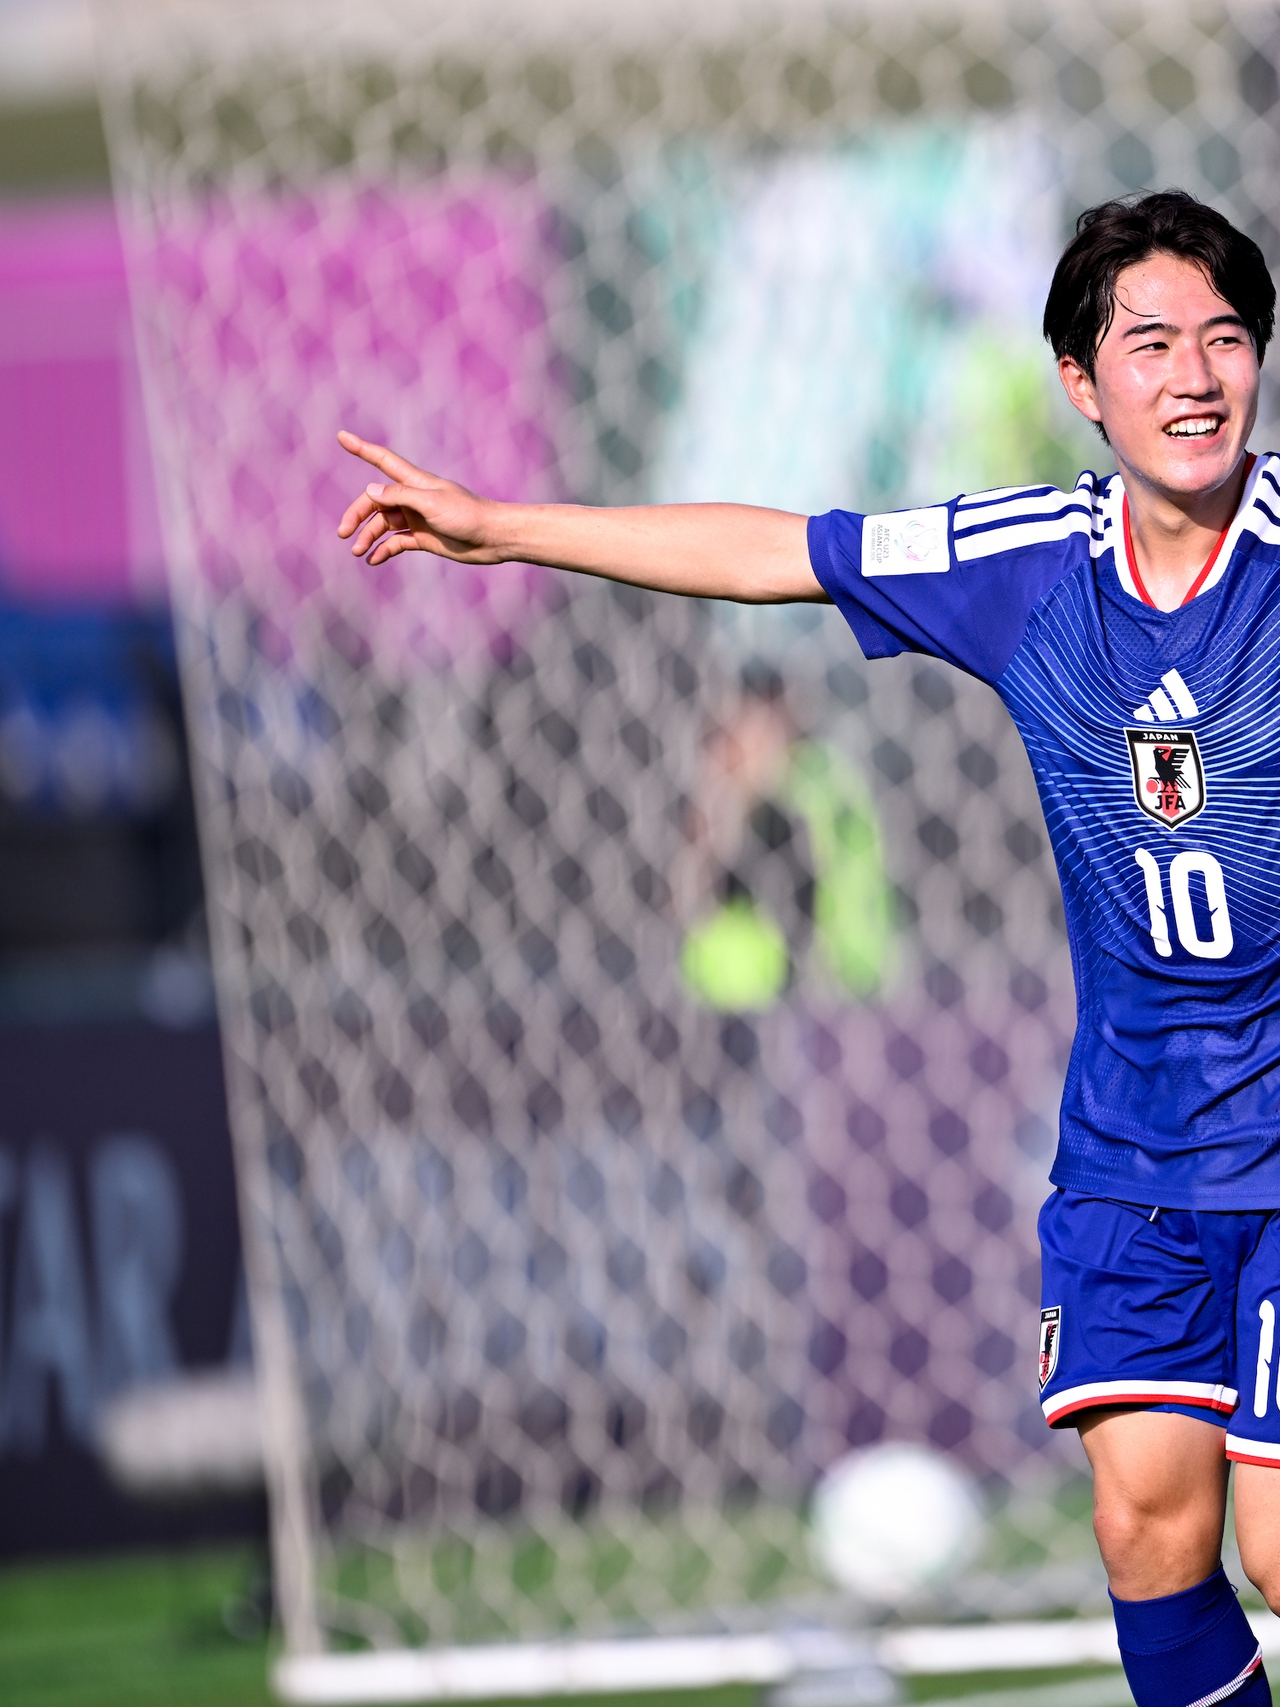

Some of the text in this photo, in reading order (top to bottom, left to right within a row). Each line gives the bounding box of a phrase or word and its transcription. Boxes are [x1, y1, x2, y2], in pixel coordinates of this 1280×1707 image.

[1143, 732, 1179, 741] JAPAN
[1155, 794, 1187, 811] JFA
[1134, 847, 1234, 959] 10
